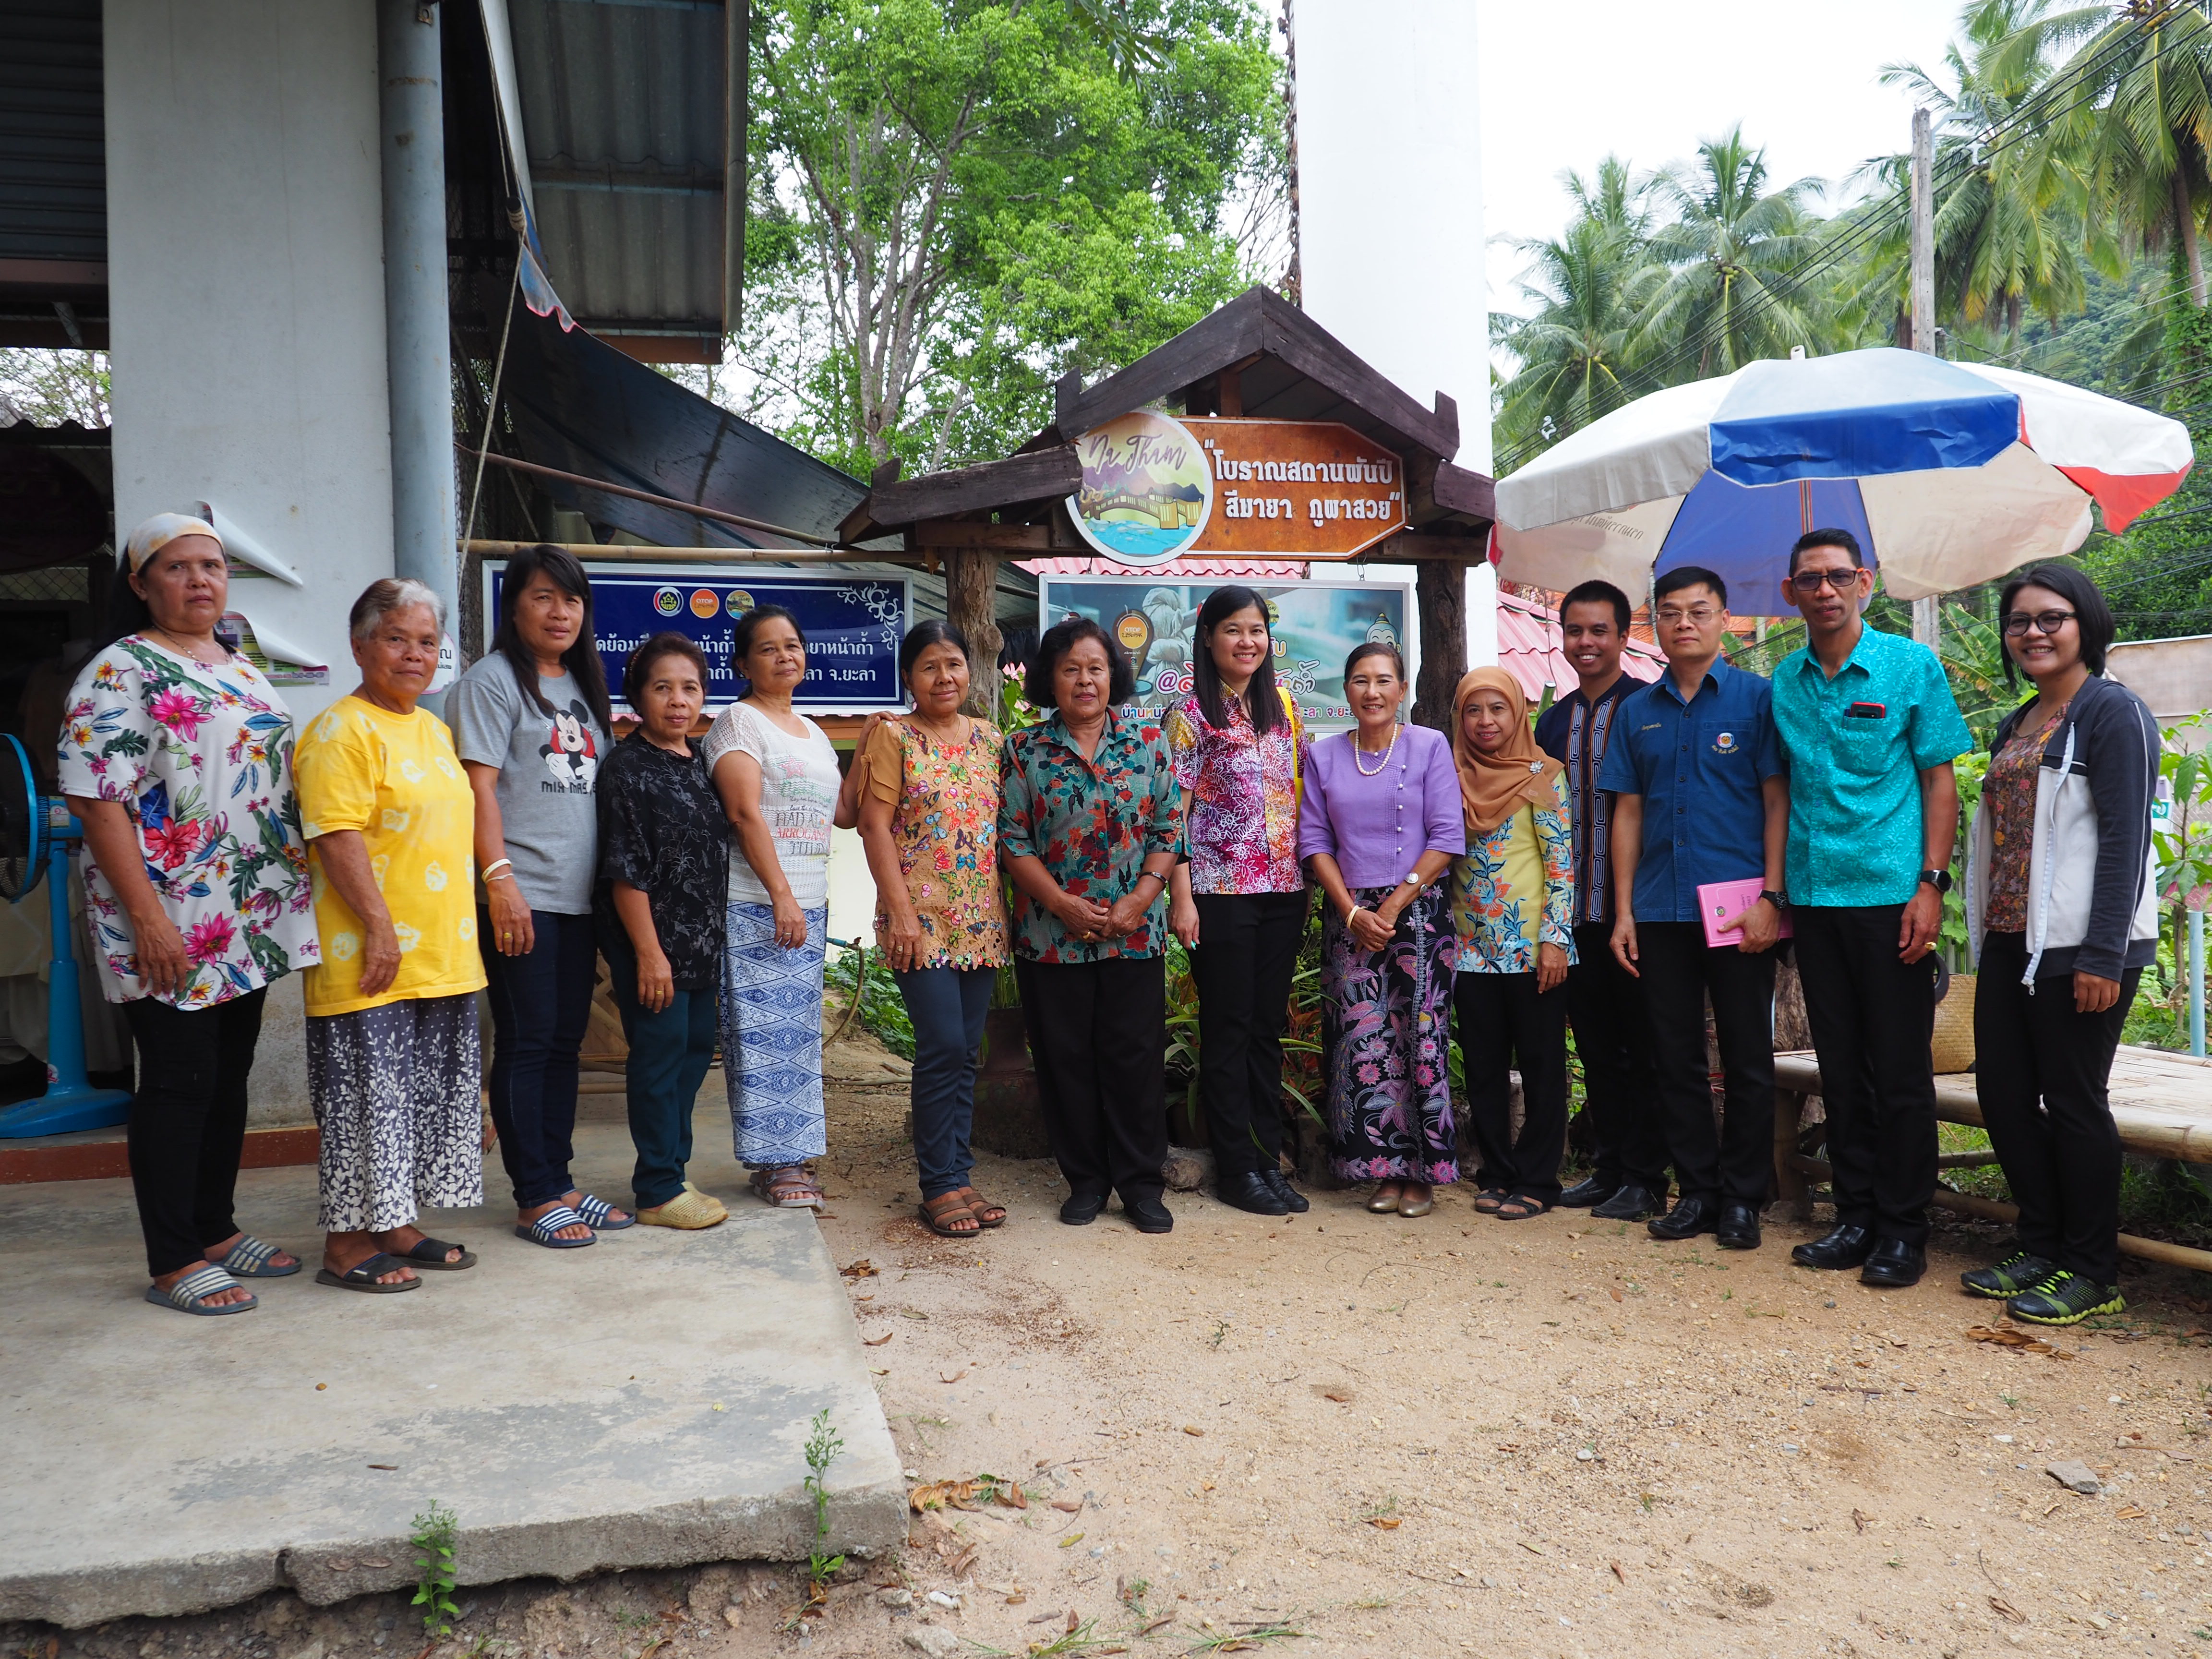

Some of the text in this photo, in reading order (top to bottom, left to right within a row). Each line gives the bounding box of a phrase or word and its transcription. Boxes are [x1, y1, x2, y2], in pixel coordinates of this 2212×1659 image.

[1224, 490, 1293, 519] สีมายา
[829, 669, 876, 681] จ.ยะลา
